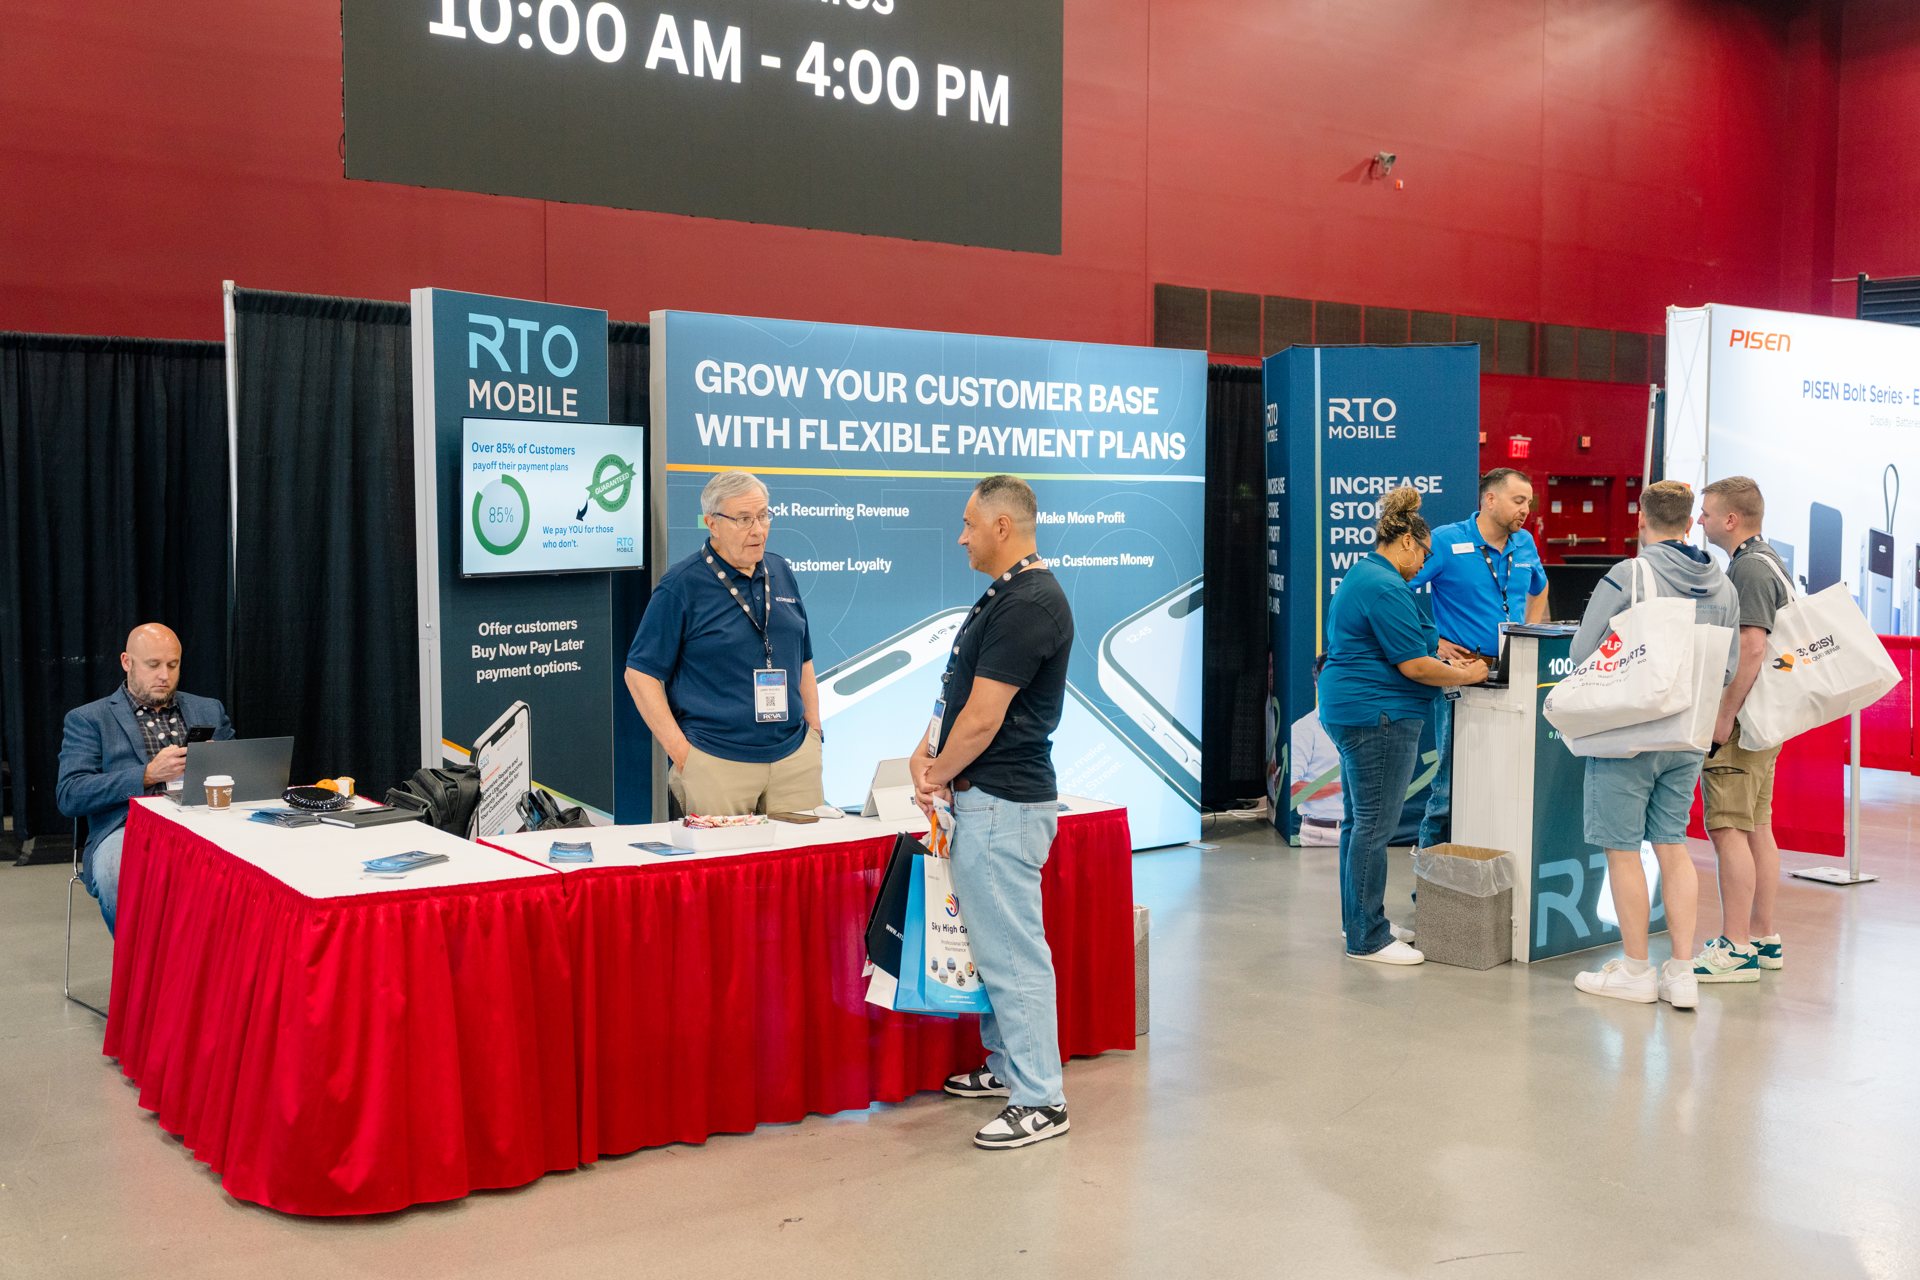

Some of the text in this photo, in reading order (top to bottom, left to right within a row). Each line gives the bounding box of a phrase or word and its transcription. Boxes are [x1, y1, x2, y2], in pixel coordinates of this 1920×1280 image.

[429, 0, 626, 63] 10:00
[645, 13, 741, 83] AM
[796, 41, 919, 111] 4:00
[937, 63, 1009, 127] PM
[468, 312, 578, 378] RTO
[695, 360, 1159, 415] GROW YOUR CUSTOMER BASE
[1803, 380, 1839, 400] PISEN
[1844, 383, 1866, 402] Bolt
[1870, 385, 1903, 404] Series
[469, 379, 578, 417] MOBILE
[1328, 398, 1397, 422] RTO
[695, 413, 1186, 460] WITH FLEXIBLE PAYMENT PLANS
[1328, 425, 1396, 439] MOBILE
[472, 442, 576, 455] Over 85% of Customers
[1512, 440, 1529, 458] EXIT
[472, 461, 568, 472] payoff their payment plans
[594, 472, 630, 494] GUARANTEED
[489, 507, 514, 524] 85%
[792, 504, 854, 520] Recurring
[856, 504, 910, 517] Revenue
[1036, 512, 1126, 524] Make More Profit
[542, 525, 614, 536] We pay YOU for those
[542, 540, 558, 548] who
[616, 538, 634, 546] RTO
[848, 558, 892, 574] Loyalty
[1062, 554, 1118, 567] Customers
[1120, 554, 1154, 568] Money
[478, 620, 578, 636] Offer customers
[472, 638, 584, 660] Buy Now Pay Later
[476, 660, 581, 684] payment options.
[931, 922, 941, 933] Sky
[942, 923, 958, 934] High
